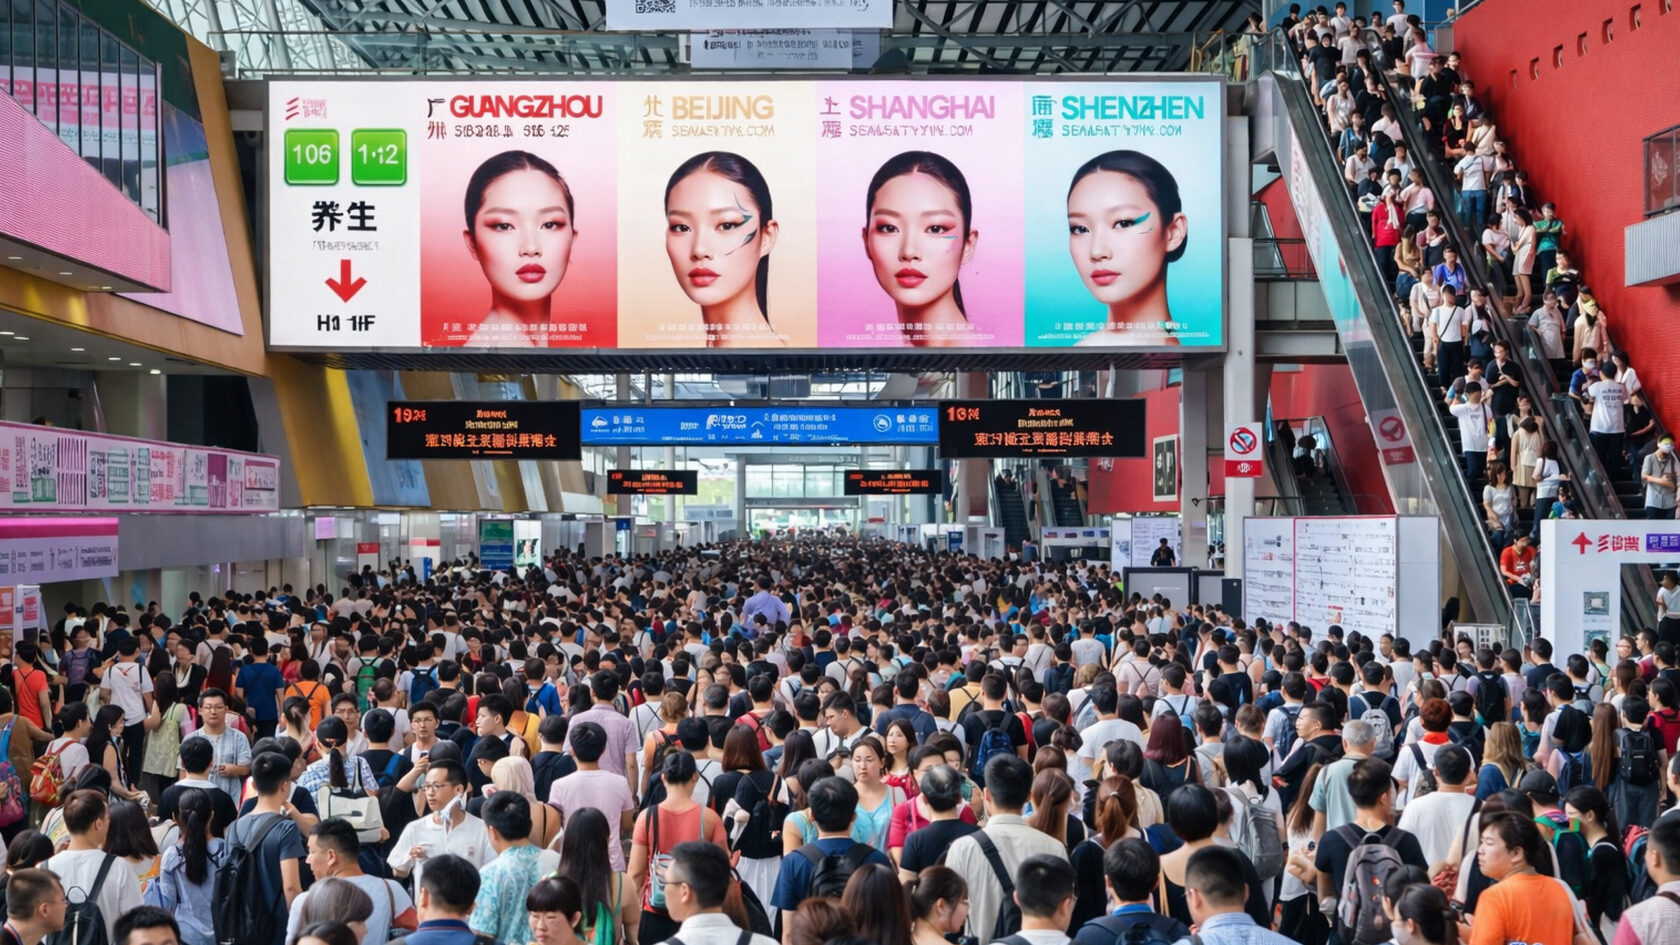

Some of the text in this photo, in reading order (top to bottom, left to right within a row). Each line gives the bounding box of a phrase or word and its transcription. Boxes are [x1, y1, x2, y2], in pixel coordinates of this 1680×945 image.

[449, 95, 603, 118] GUANGZHOU
[672, 95, 775, 120] BEIJING
[849, 95, 995, 119] SHANGHAI
[1062, 95, 1204, 120] SHENZHEN
[293, 144, 332, 164] 106
